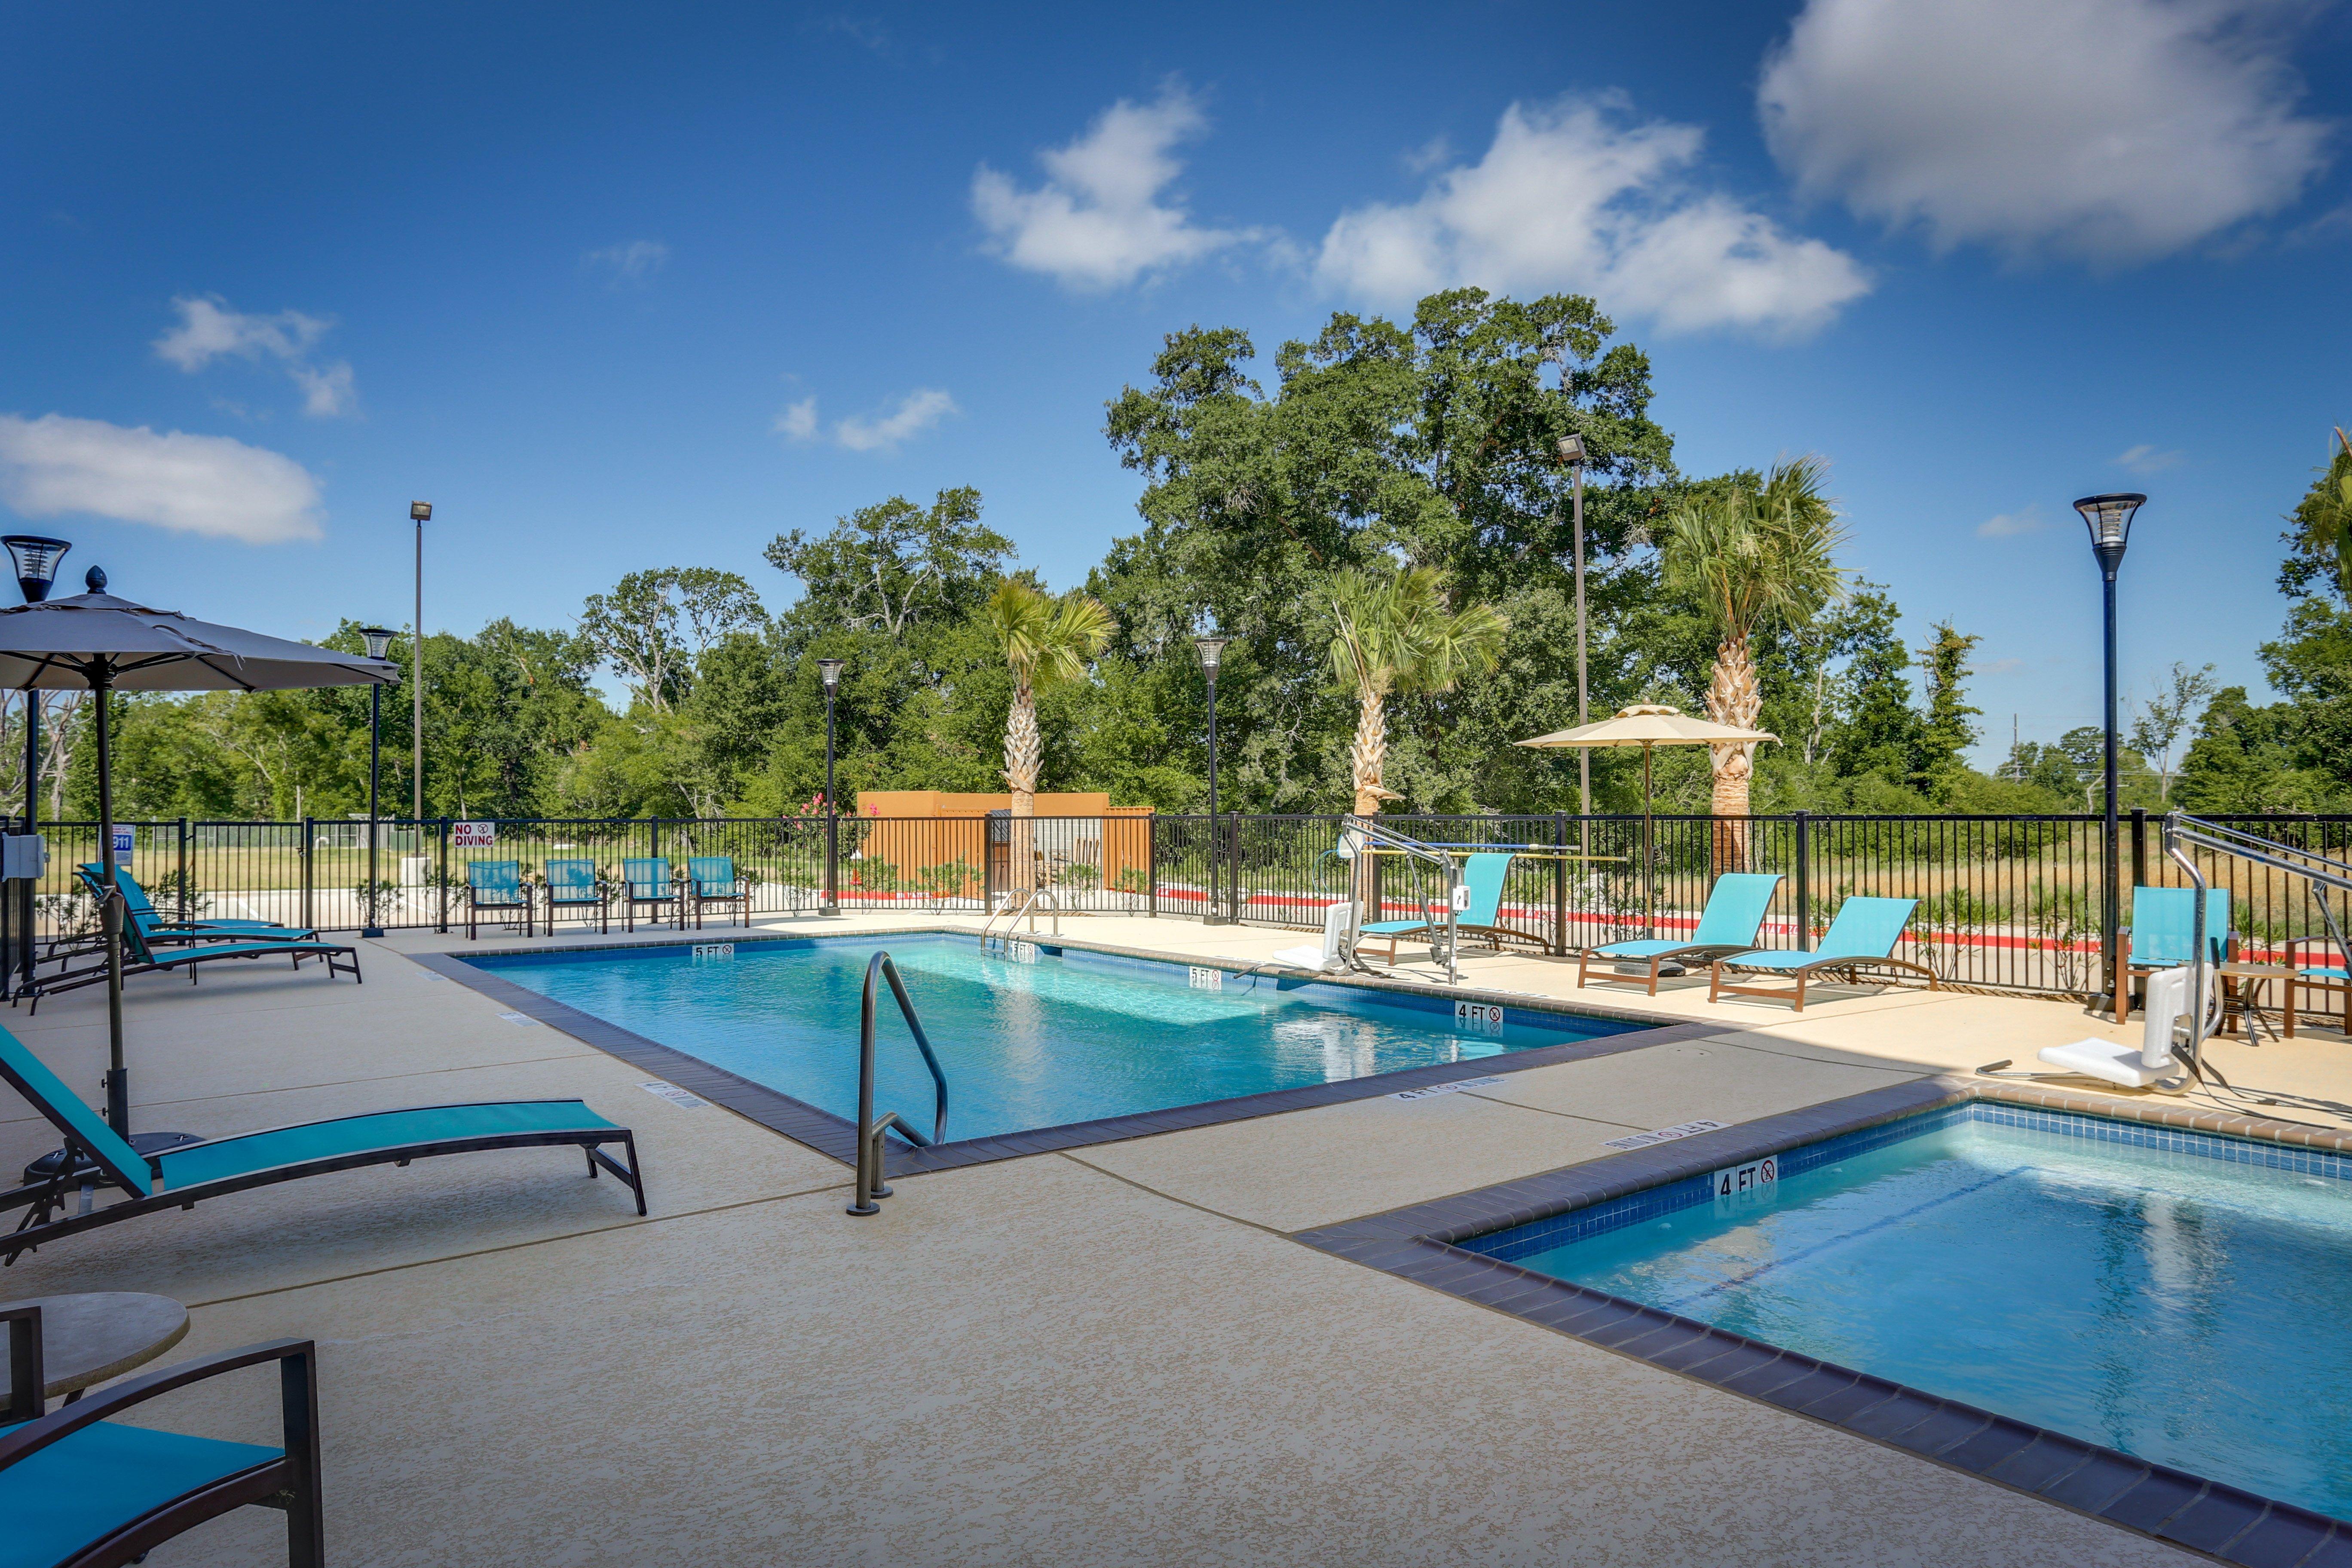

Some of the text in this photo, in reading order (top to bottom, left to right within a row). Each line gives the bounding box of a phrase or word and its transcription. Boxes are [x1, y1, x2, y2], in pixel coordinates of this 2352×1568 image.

[456, 824, 471, 834] NO
[113, 836, 129, 848] 911
[456, 835, 493, 845] DIVING
[696, 946, 719, 956] 5 FT
[1192, 969, 1209, 979] 5 FT
[1459, 1004, 1485, 1020] 4 FT
[1673, 1124, 1706, 1133] FT
[1721, 1167, 1756, 1195] 4 FT
